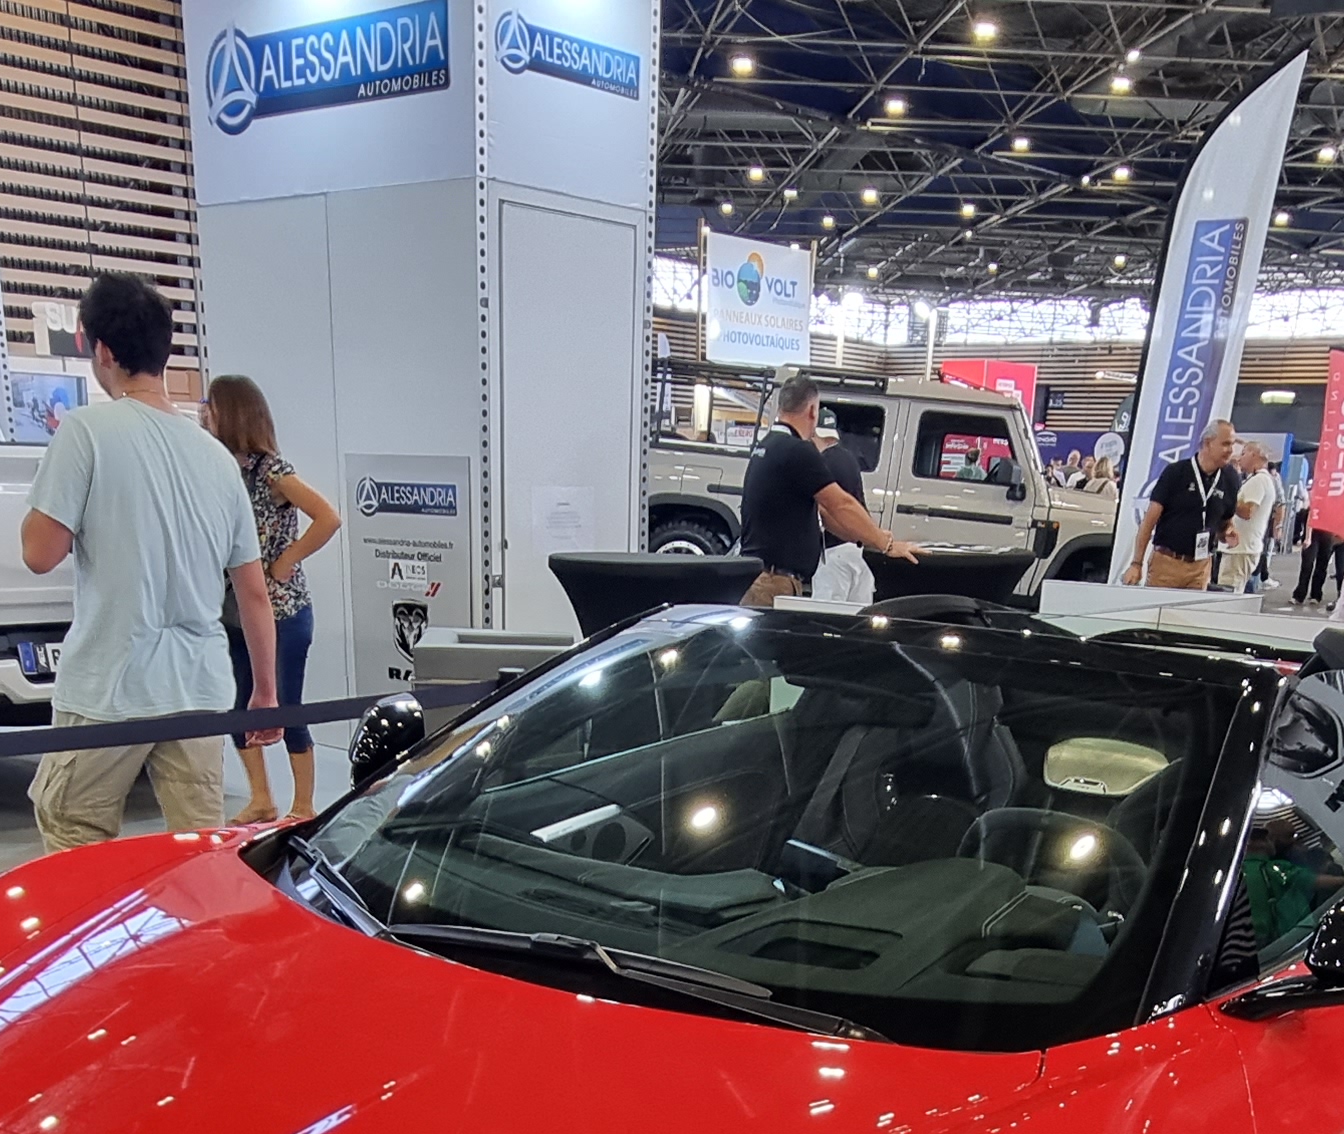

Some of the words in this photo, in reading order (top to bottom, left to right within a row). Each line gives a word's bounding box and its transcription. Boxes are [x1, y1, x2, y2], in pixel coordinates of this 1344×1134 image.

[259, 11, 445, 93] ALESSANDRIA
[532, 32, 638, 86] ALESSANDRIA
[357, 69, 446, 98] AUTOMOBILES
[591, 77, 638, 98] AUTOMOBILES
[712, 267, 735, 289] BIO
[765, 276, 798, 298] VOLT
[764, 314, 804, 332] SOLAIRES
[719, 330, 800, 352] HOTOVOLTAÏQUES
[1159, 223, 1230, 463] ALESSANDRIA
[379, 486, 456, 506] ALESSANDRIA
